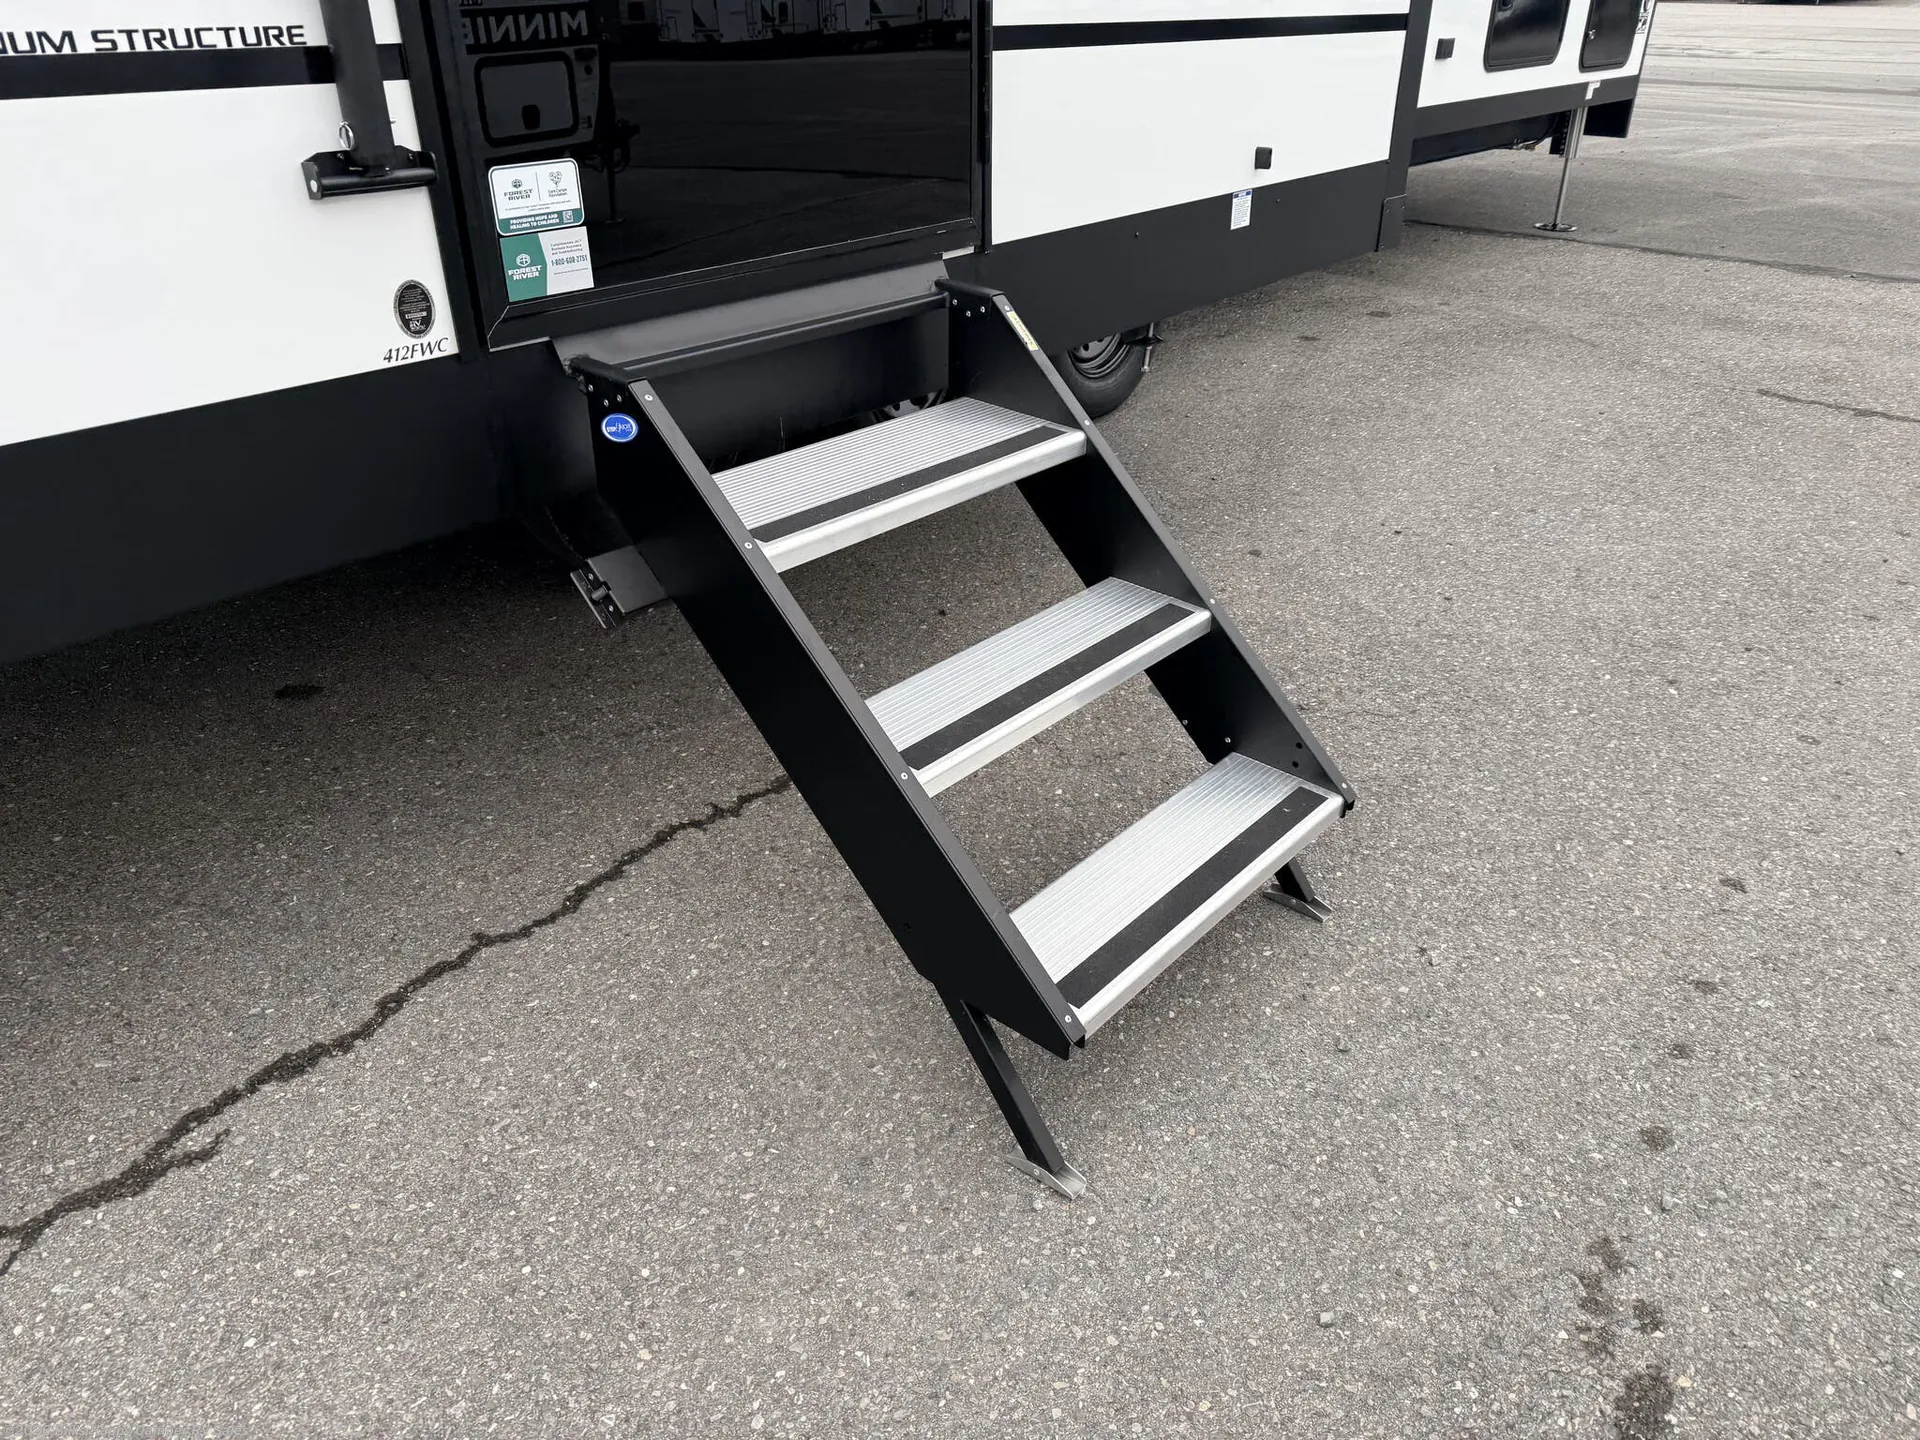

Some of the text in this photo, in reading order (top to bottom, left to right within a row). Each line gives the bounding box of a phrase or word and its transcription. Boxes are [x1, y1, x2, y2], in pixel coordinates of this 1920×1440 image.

[91, 25, 307, 51] STRUCTURE
[504, 189, 533, 197] FOREST
[508, 265, 542, 276] FOREST
[513, 271, 540, 281] RIVER
[383, 337, 449, 363] 412FWC
